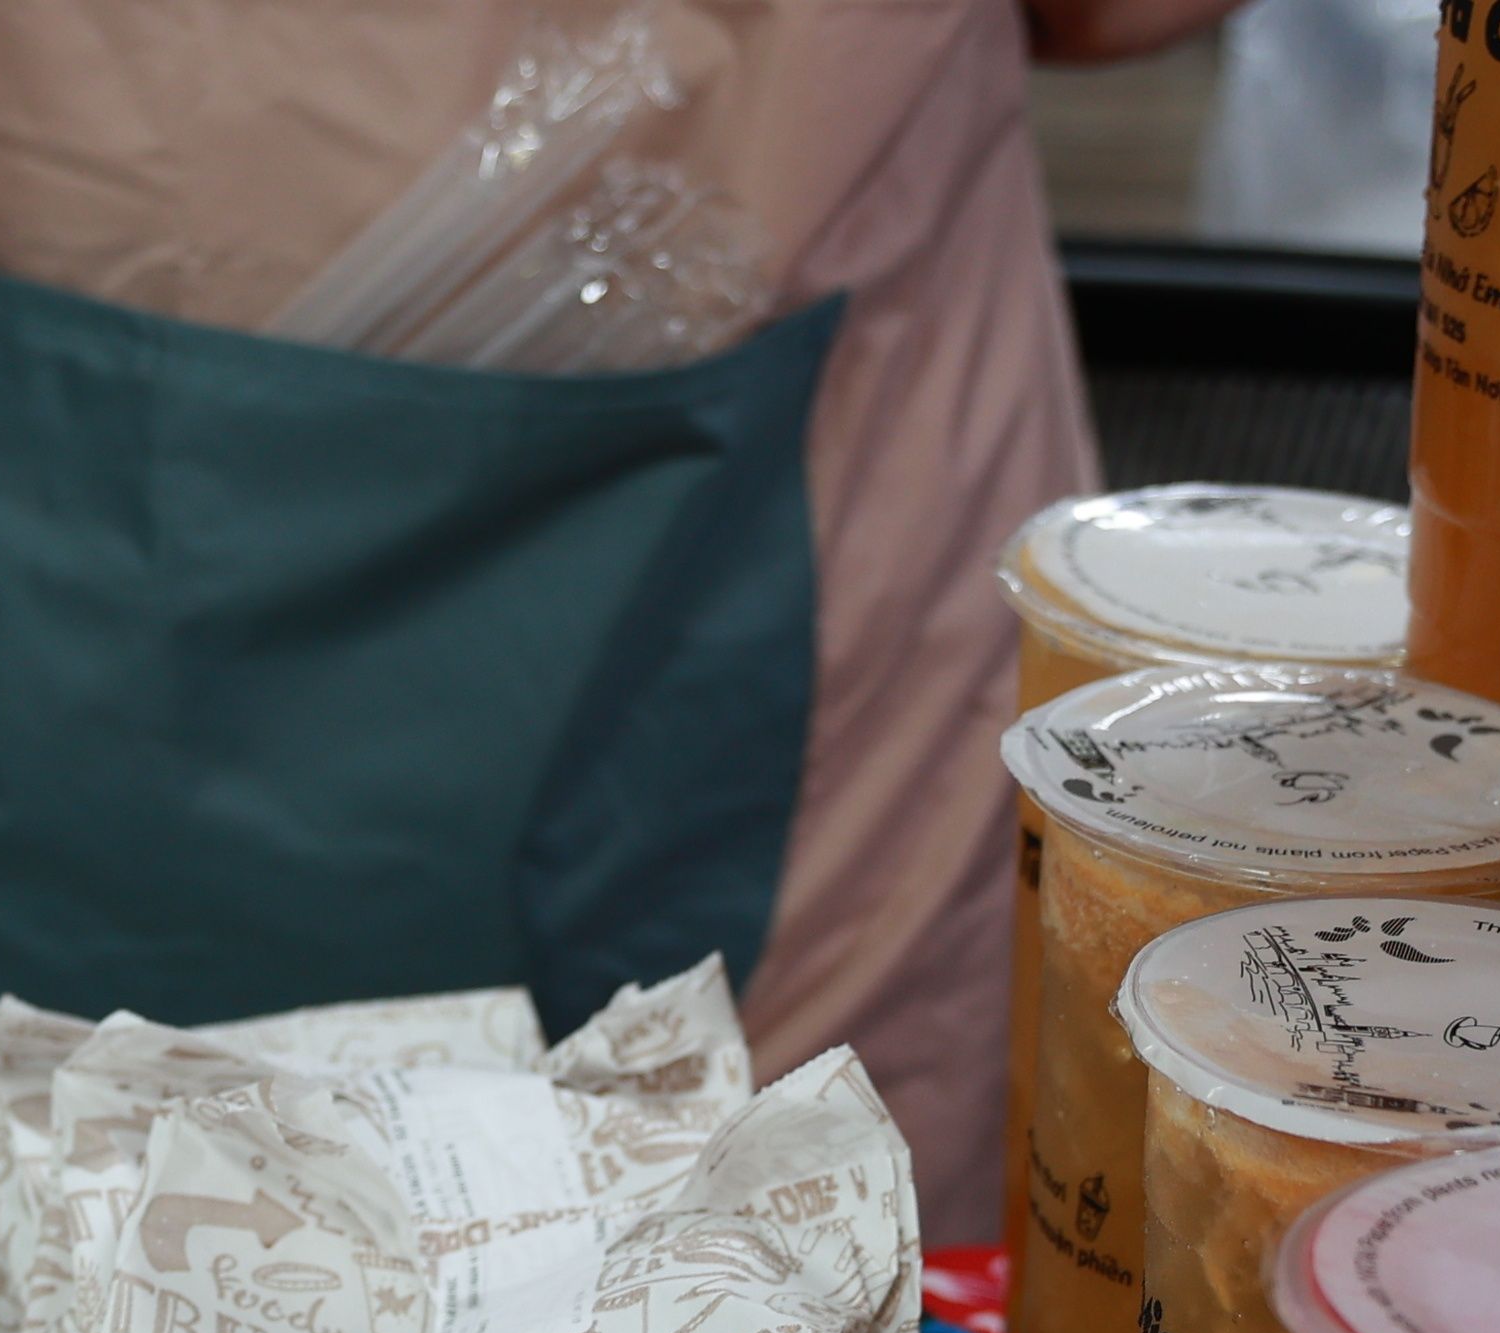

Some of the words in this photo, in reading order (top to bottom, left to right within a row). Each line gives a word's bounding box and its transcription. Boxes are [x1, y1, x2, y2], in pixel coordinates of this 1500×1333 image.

[1212, 838, 1248, 853] not
[1255, 845, 1323, 860] plants
[1331, 848, 1382, 861] from
